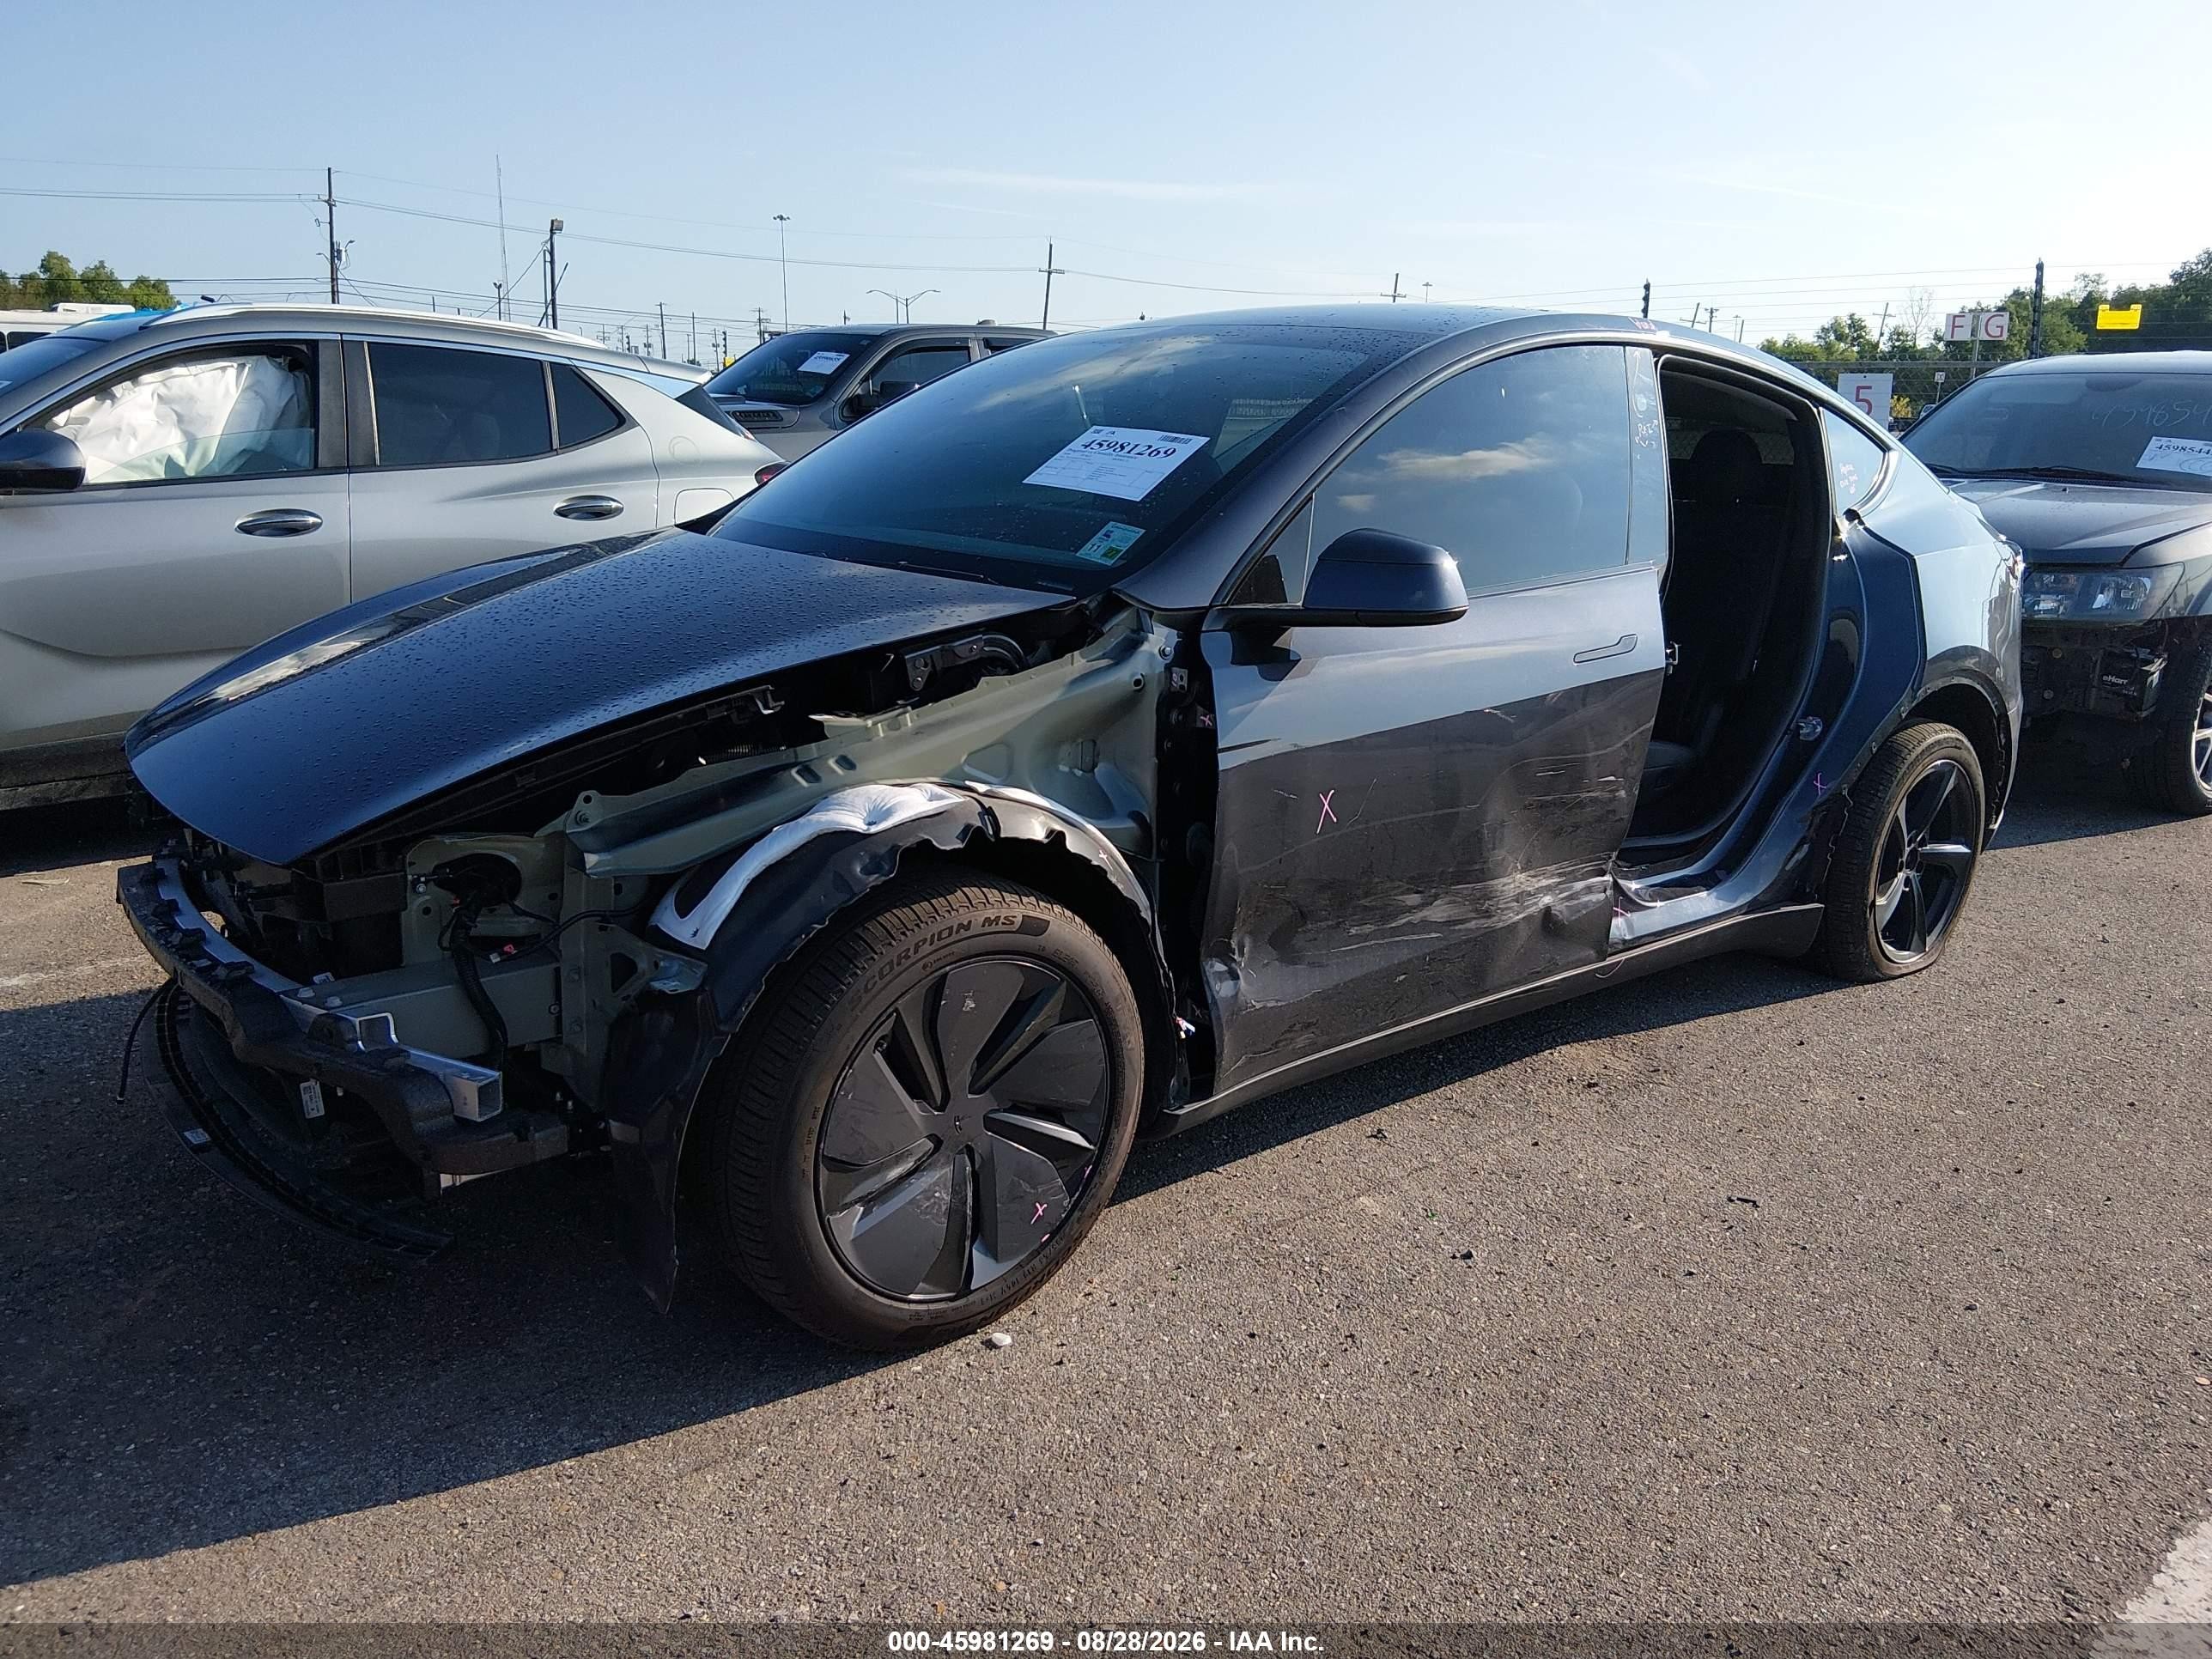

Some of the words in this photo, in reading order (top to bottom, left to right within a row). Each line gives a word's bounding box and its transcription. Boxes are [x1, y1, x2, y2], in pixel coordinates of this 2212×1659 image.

[1950, 314, 1966, 339] F
[1984, 313, 2004, 339] G
[1854, 385, 1874, 416] 5
[1081, 439, 1177, 459] 45981269
[2155, 443, 2212, 457] 4598544
[849, 920, 973, 1011] SCORPION
[981, 914, 1018, 929] MS
